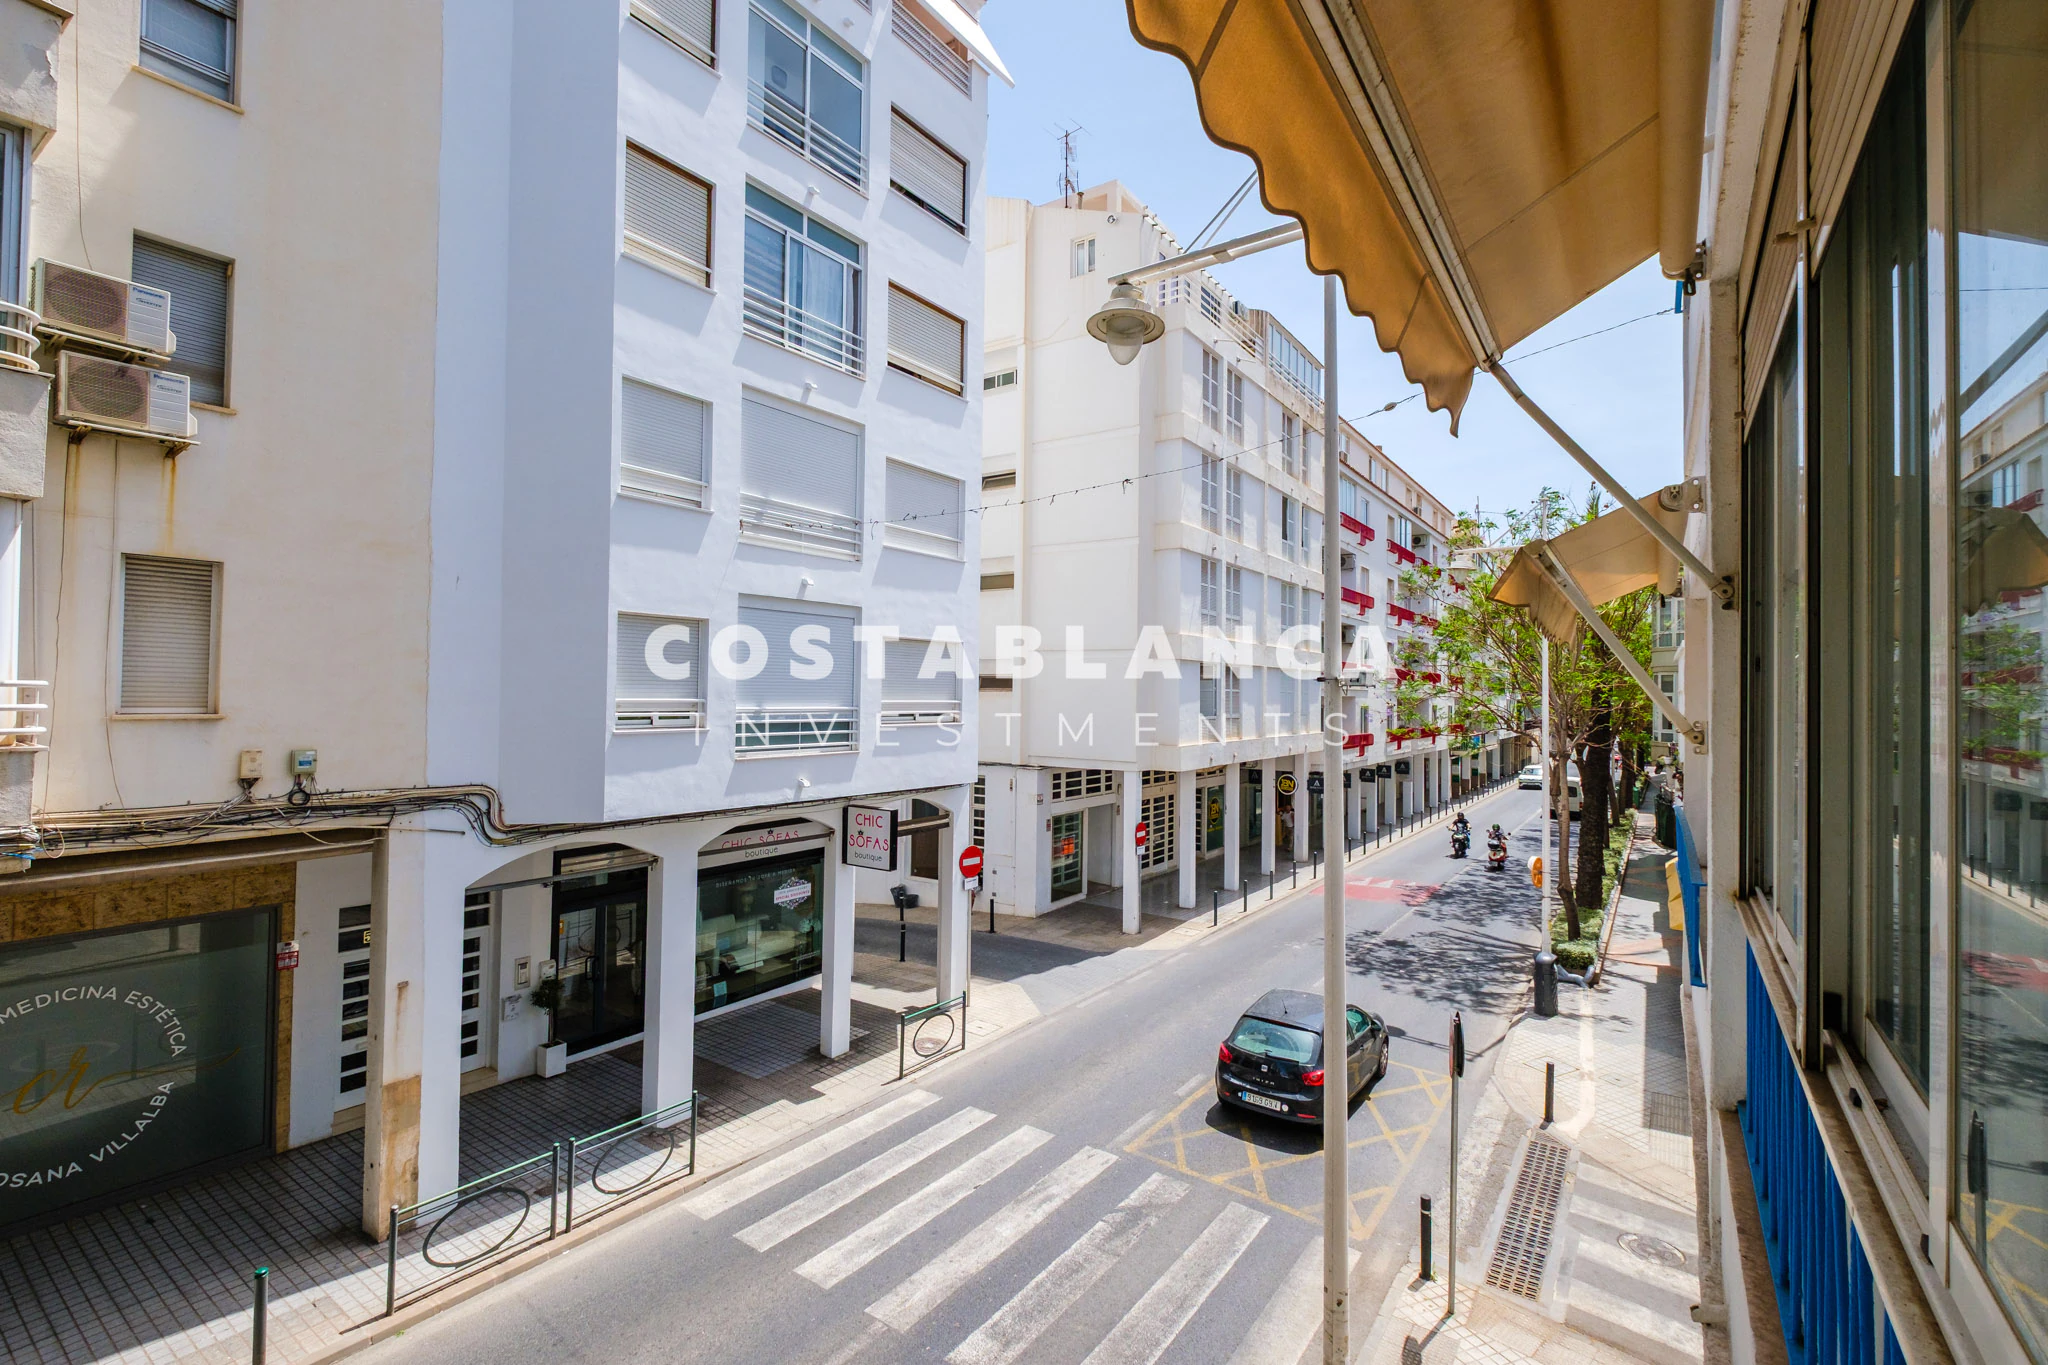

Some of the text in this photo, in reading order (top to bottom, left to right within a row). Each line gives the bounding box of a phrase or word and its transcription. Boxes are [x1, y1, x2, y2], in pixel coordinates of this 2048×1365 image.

[855, 813, 883, 828] CHIC
[848, 834, 889, 851] SOFAS
[744, 847, 779, 858] boutique
[854, 851, 882, 862] boutique
[0, 986, 188, 1057] MEDICINA ESTÉTICA
[89, 1081, 175, 1162] VILLALBA
